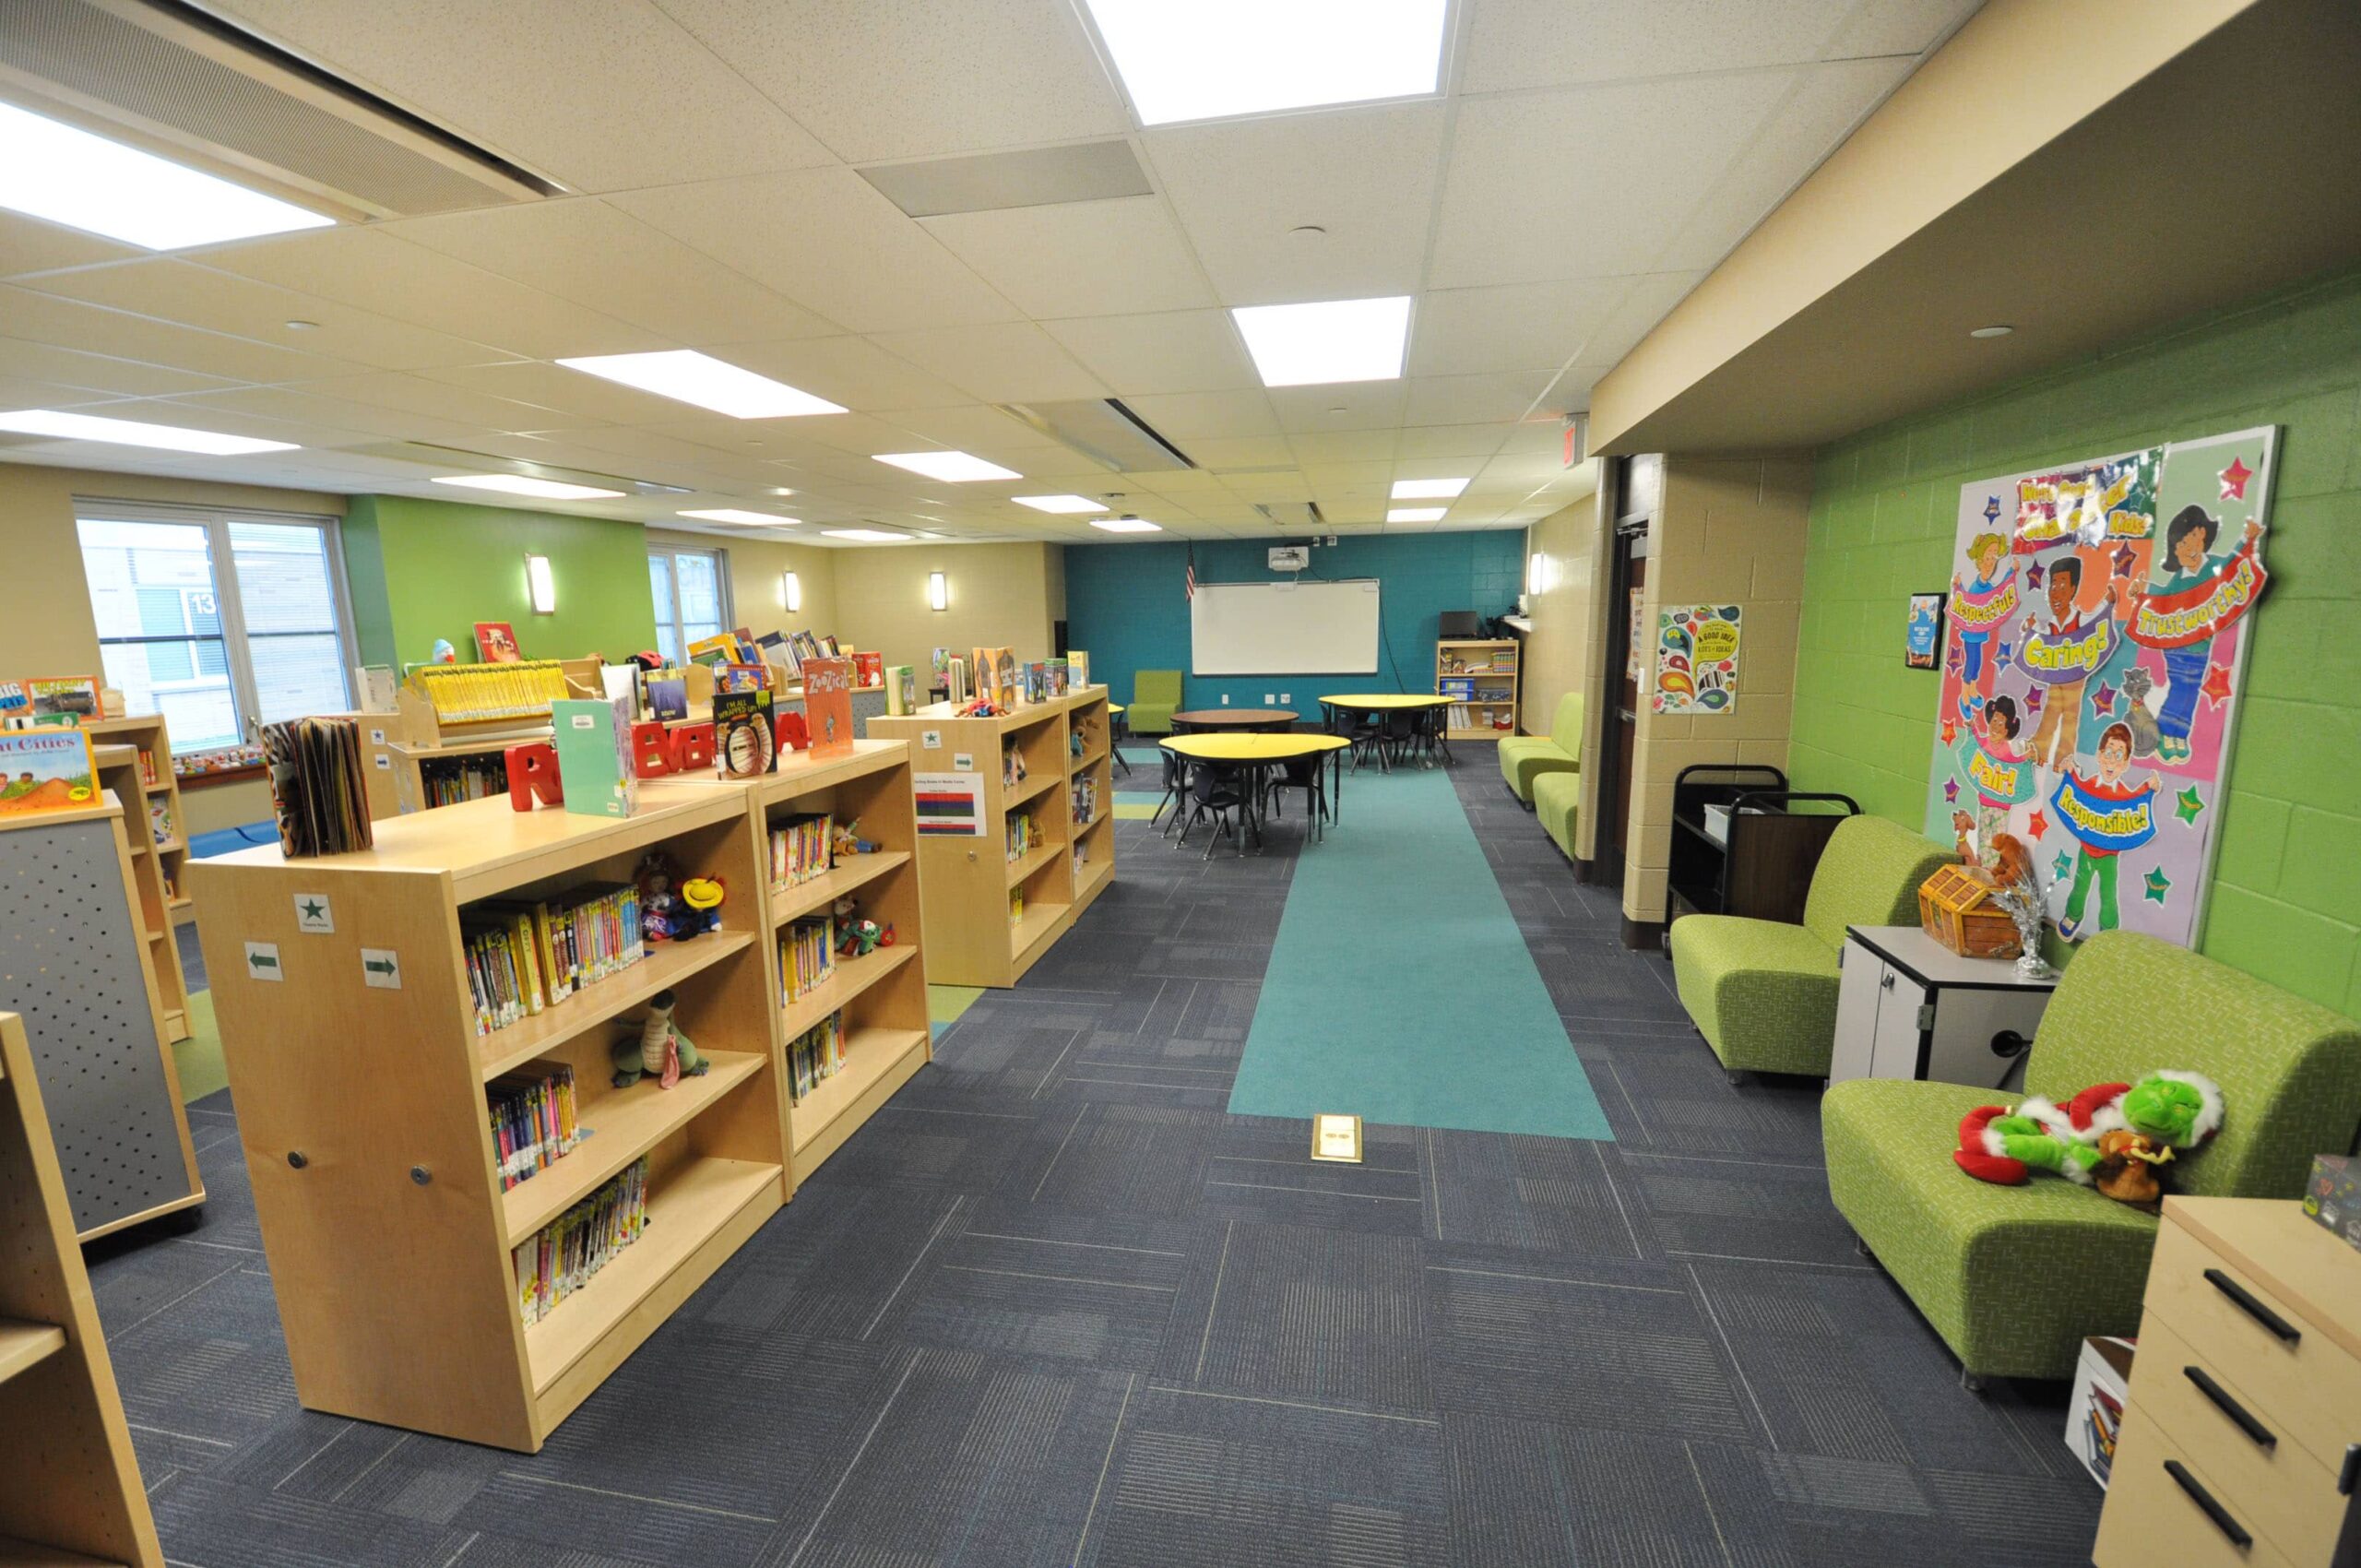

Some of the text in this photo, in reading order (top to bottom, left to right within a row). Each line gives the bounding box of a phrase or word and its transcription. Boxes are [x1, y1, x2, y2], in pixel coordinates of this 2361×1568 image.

[1952, 587, 2016, 624] Respectful!
[2136, 558, 2256, 638] Trustworthy!
[2024, 621, 2109, 670] Caring!
[18, 738, 76, 751] Cities
[1968, 754, 2017, 797] Fair!
[2058, 785, 2148, 837] Responsible!
